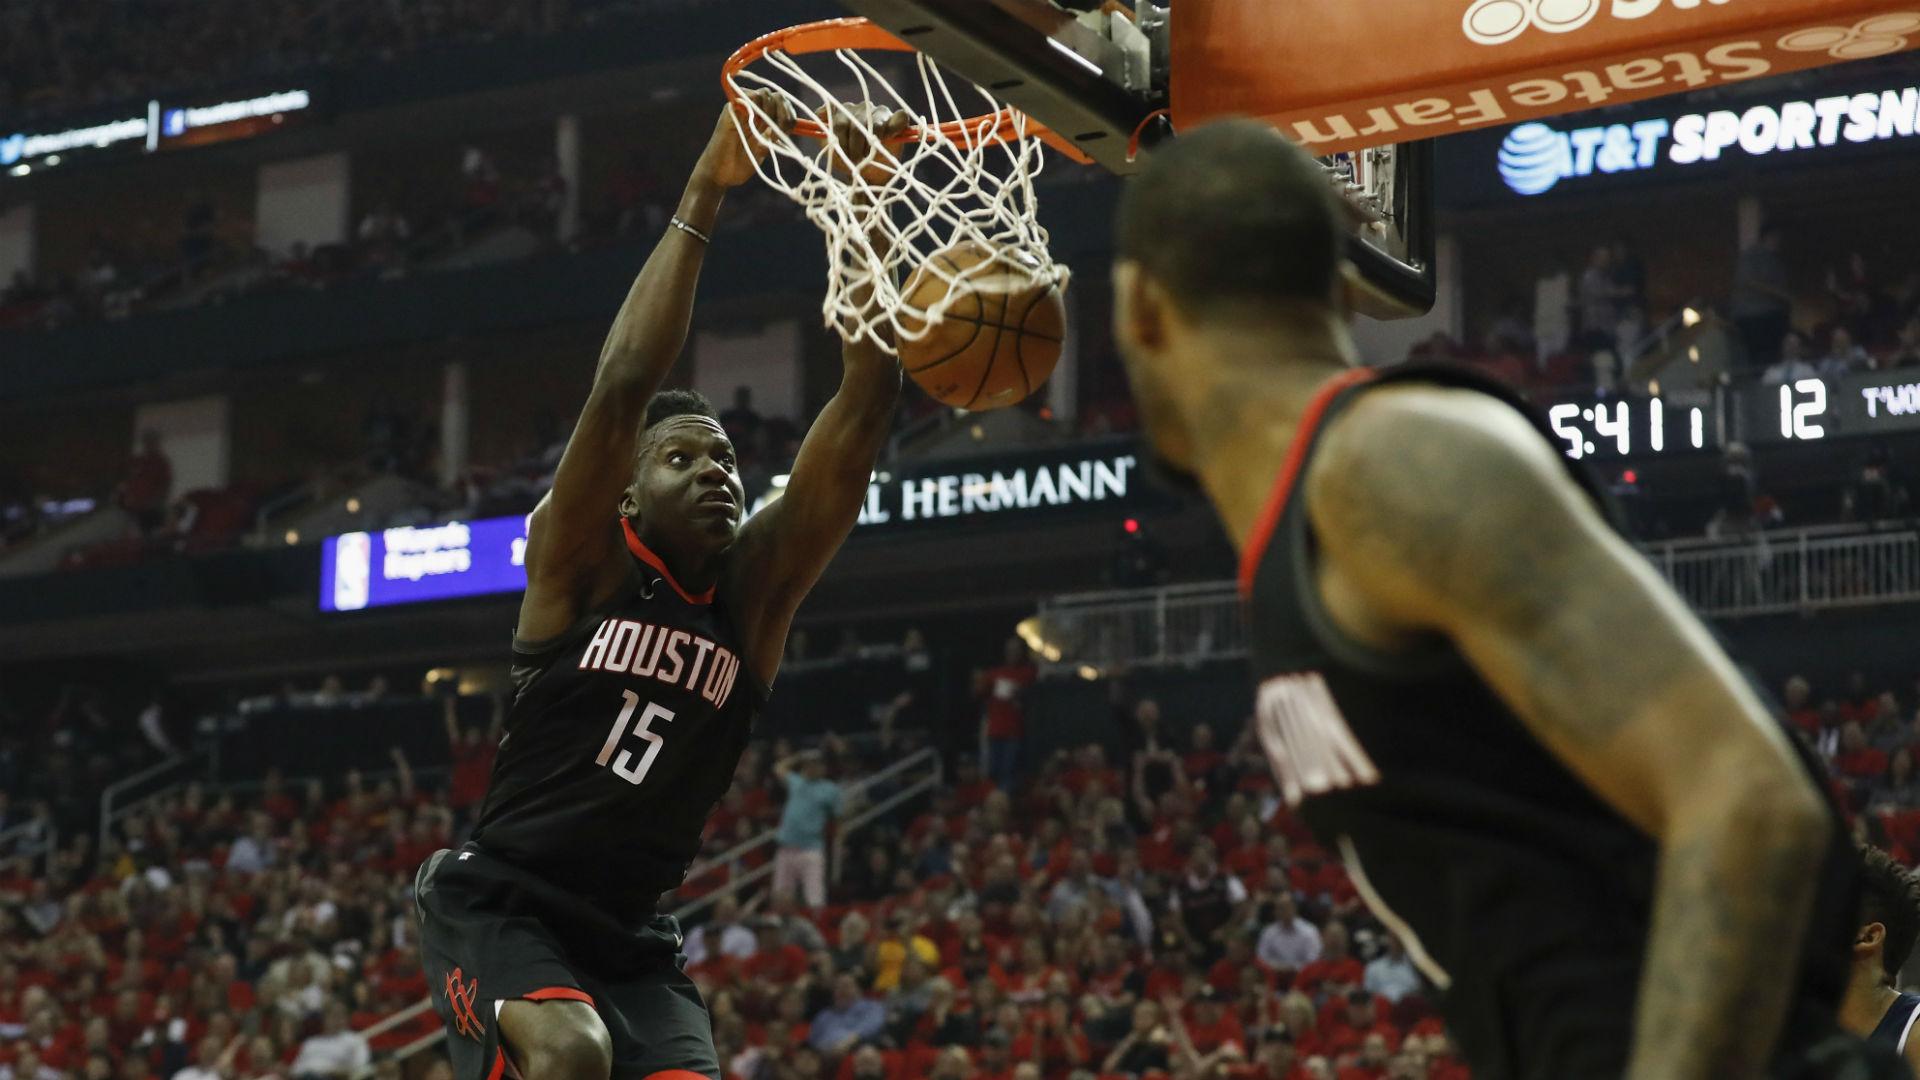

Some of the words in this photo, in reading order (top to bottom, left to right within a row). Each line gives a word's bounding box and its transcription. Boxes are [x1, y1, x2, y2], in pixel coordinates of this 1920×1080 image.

[1669, 86, 1920, 164] SPORTSN
[1549, 397, 1663, 459] 5:41
[1780, 378, 1827, 440] 12
[578, 618, 740, 710] HOUSTON
[595, 688, 676, 785] 15
